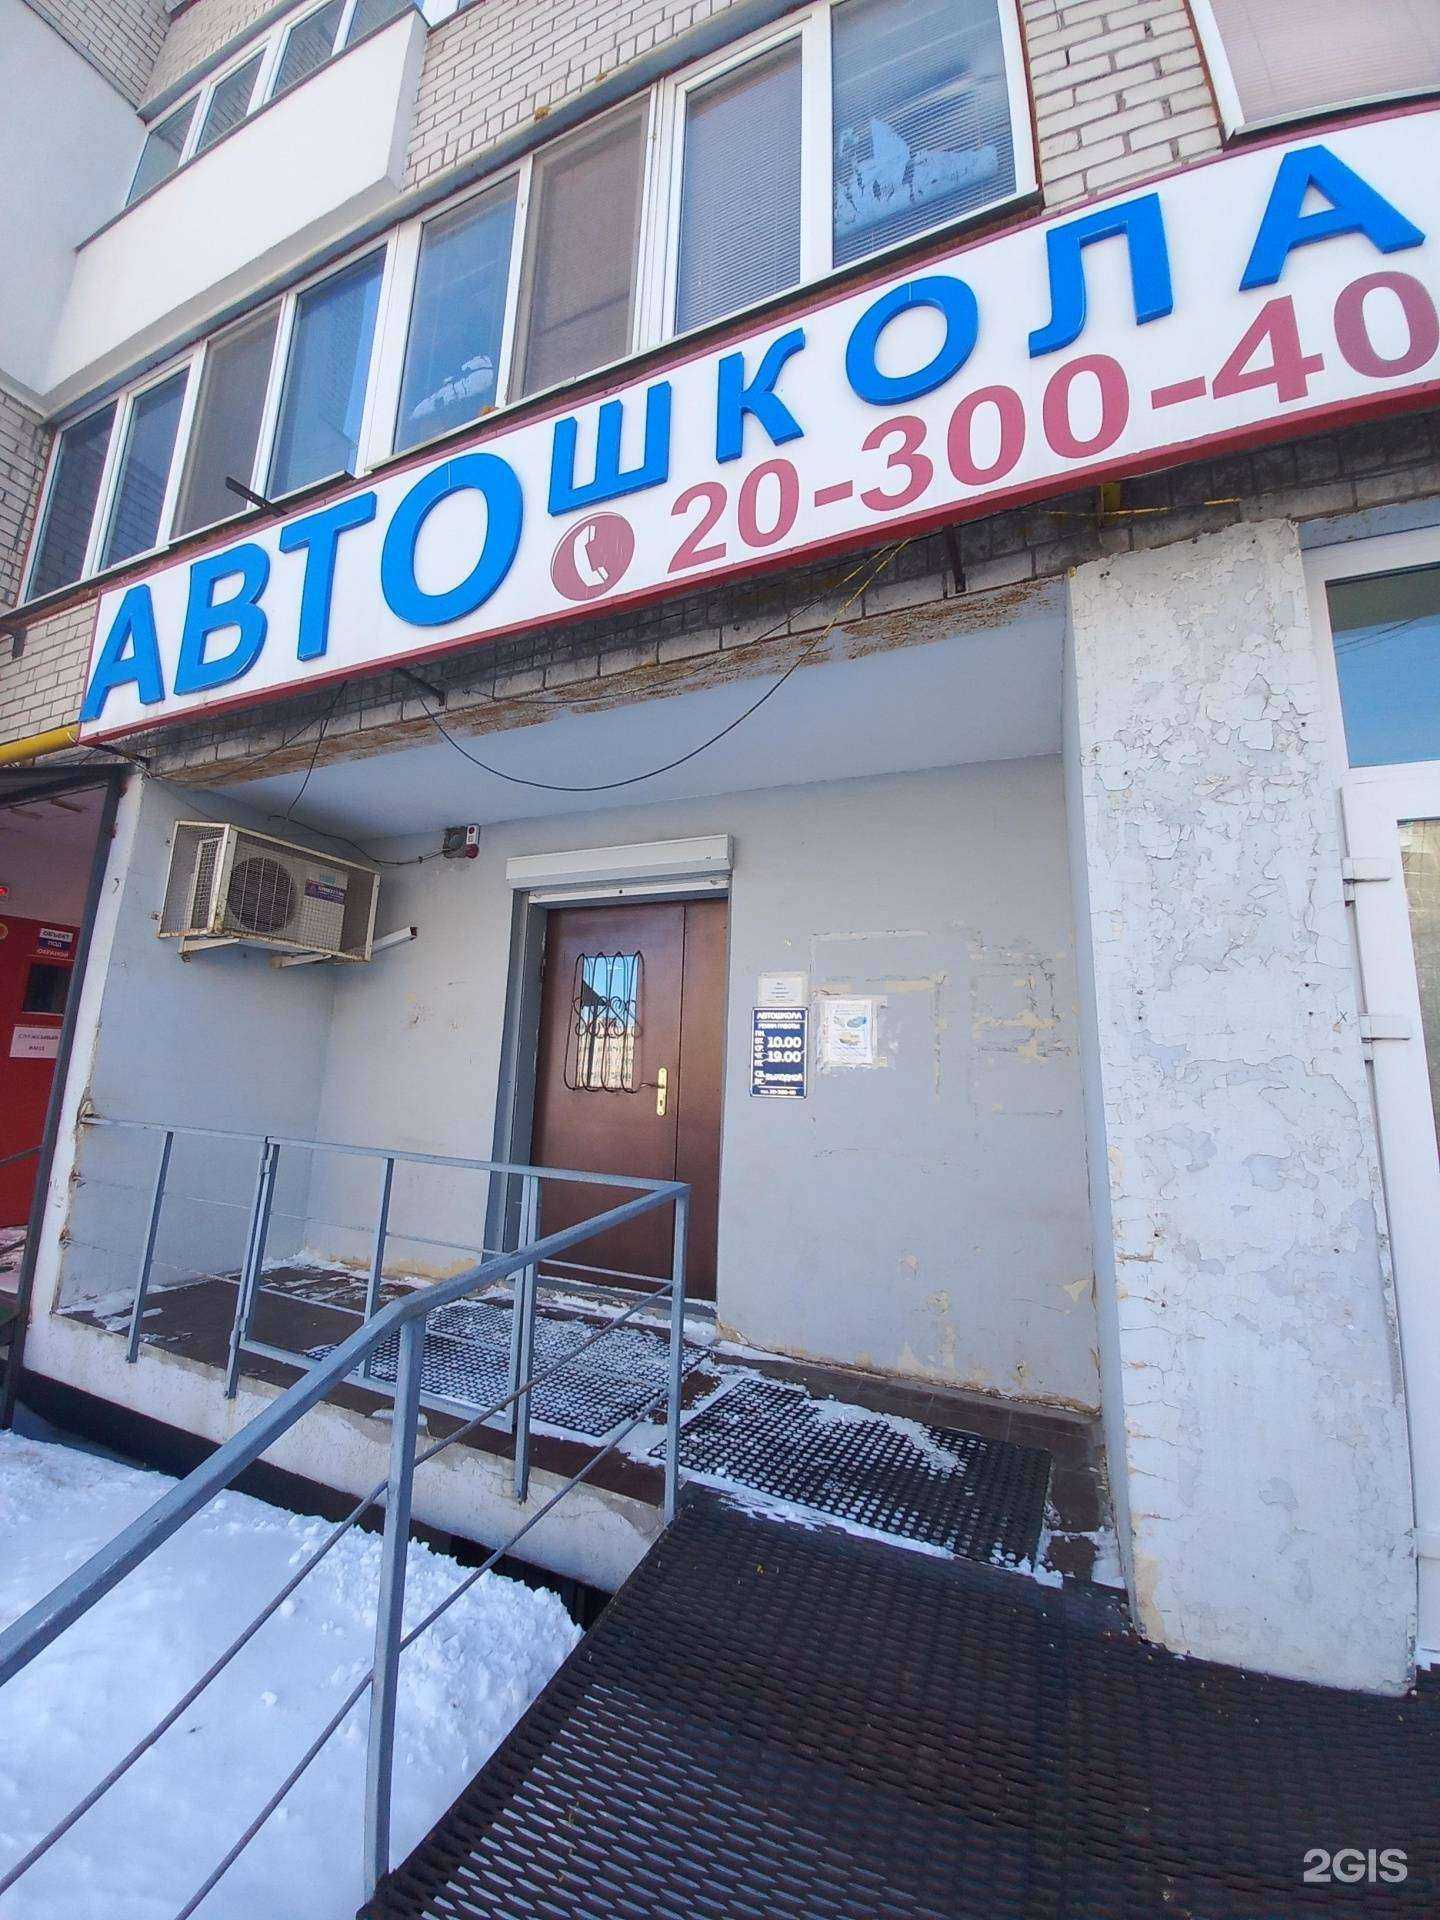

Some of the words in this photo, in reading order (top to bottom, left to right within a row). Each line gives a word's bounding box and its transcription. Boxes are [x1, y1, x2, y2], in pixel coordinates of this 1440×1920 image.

[79, 144, 1425, 723] АВТОШКОЛА
[667, 270, 1440, 573] 20-300-40
[756, 1011, 803, 1020] АВТОШКОЛА
[767, 1036, 802, 1048] 10.00
